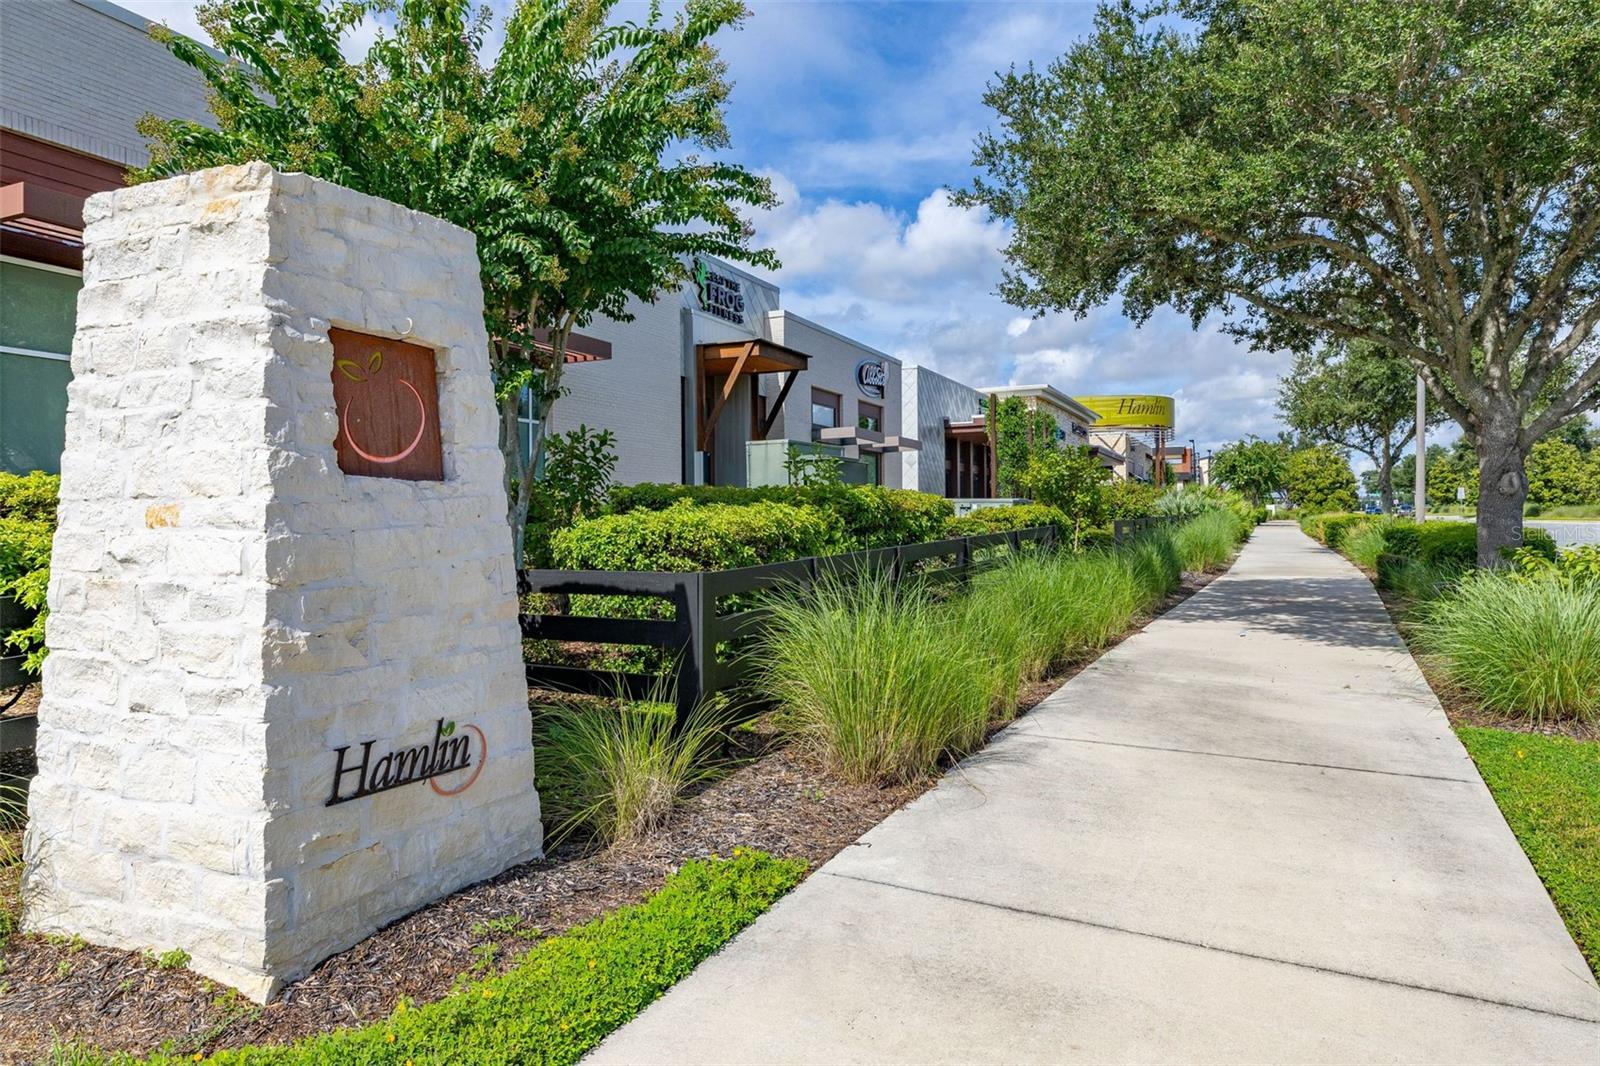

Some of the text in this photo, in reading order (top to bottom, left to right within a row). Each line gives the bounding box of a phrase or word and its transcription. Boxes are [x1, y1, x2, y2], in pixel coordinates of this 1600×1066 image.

[707, 282, 744, 312] FROG
[708, 304, 744, 324] FITNESS
[1116, 398, 1166, 416] Hamlin
[325, 717, 472, 807] Hamlin
